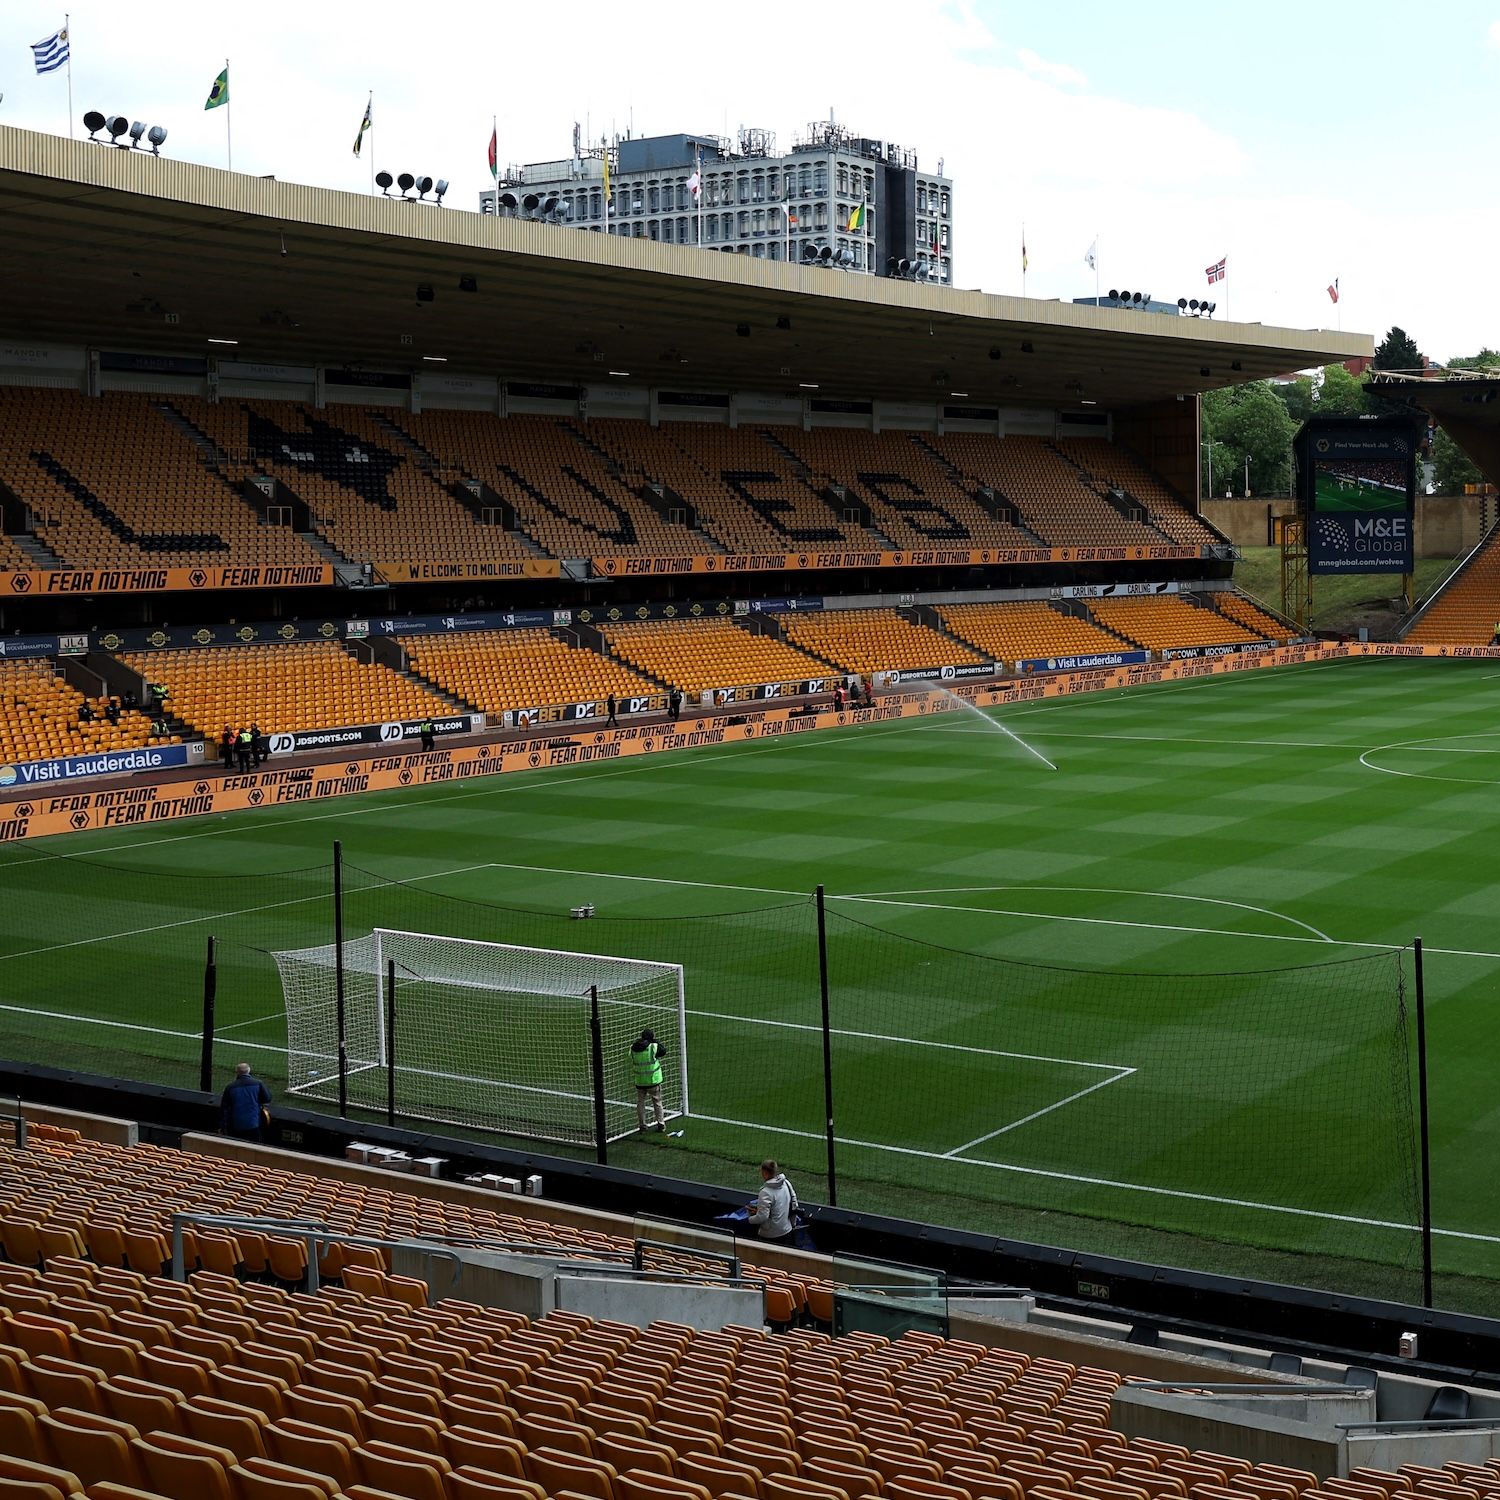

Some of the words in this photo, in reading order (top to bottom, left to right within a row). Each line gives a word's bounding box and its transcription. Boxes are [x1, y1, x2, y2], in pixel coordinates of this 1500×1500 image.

[168, 315, 177, 323] 11
[1354, 518, 1406, 537] M&E
[1354, 538, 1407, 552] Global
[911, 553, 934, 565] FEAR
[936, 551, 970, 565] NOTHING
[997, 550, 1019, 562] FEAR
[1019, 549, 1051, 562] NOTHING
[1076, 549, 1097, 560] FEAR
[1098, 548, 1127, 560] NOTHING
[1150, 547, 1168, 559] FEAR
[1169, 546, 1196, 558] NOTHING
[625, 559, 651, 574] FEAR
[652, 558, 693, 572] NOTHING
[724, 556, 748, 570] FEAR
[749, 554, 786, 569] NOTHING
[817, 554, 842, 567] FEAR
[844, 553, 881, 566] NOTHING
[221, 567, 260, 586] FEAR
[262, 566, 323, 585] NOTHING
[466, 563, 478, 576] TO
[480, 562, 525, 576] MOLINEUX
[48, 571, 94, 591] FEAR
[98, 570, 168, 590] NOTHING
[1072, 586, 1098, 596] CARLING
[1128, 583, 1151, 594] CARLING
[350, 623, 366, 632] JL5
[64, 638, 84, 648] JL4
[1375, 645, 1394, 655] FEAR
[1395, 645, 1424, 656] NOTHING
[1454, 646, 1473, 656] FEAR
[1058, 658, 1075, 669] Visit
[1077, 654, 1122, 667] Lauderdale
[956, 666, 993, 675] JDSPORTS.COM
[1182, 667, 1195, 677] FEAR
[1195, 664, 1214, 675] NOTHING
[1128, 675, 1142, 685] FEAR
[1142, 671, 1162, 683] NOTHING
[1068, 683, 1084, 693] FEAR
[1084, 679, 1106, 691] NOTHING
[1002, 690, 1020, 701] FEAR
[1020, 687, 1045, 698] NOTHING
[575, 701, 622, 719] DEBT
[852, 710, 872, 722] FEAR
[873, 705, 902, 718] NOTHING
[762, 720, 784, 735] FEAR
[785, 715, 817, 732] NOTHING
[296, 731, 362, 746] JDSPORTS.COM
[662, 732, 686, 749] FEAR
[688, 727, 724, 747] NOTHING
[194, 743, 203, 753] 10
[551, 747, 577, 764] FEAR
[578, 743, 621, 762] NOTHING
[22, 758, 61, 783] Visit
[64, 750, 162, 778] Lauderdale
[423, 764, 453, 782] FEAR
[456, 756, 503, 778] NOTHING
[277, 781, 312, 802] FEAR
[311, 774, 369, 797] NOTHING
[104, 803, 146, 826] FEAR
[150, 795, 214, 819] NOTHING
